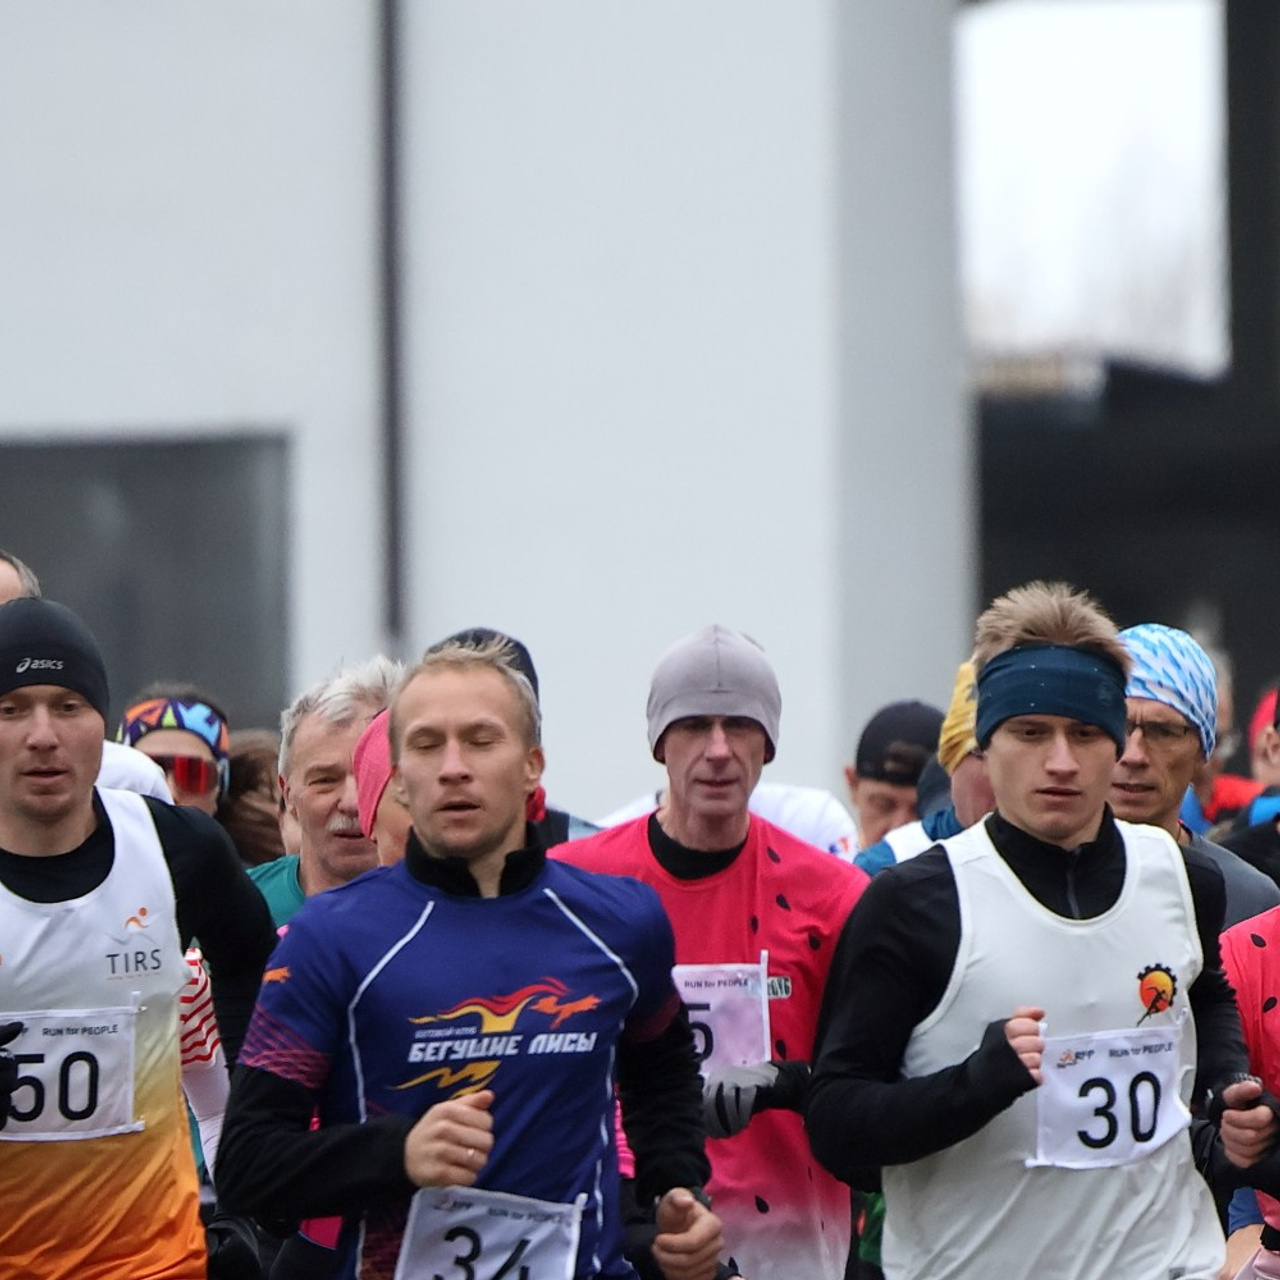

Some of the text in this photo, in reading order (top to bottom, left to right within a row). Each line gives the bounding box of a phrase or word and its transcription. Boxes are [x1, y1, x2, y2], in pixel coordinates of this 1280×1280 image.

[105, 948, 162, 974] TIRS
[684, 978, 749, 989] RUN for PEOPLE
[42, 1027, 63, 1037] RUN
[81, 1024, 119, 1036] PEOPLE
[527, 1032, 598, 1055] ЛИСЫ
[1109, 1048, 1130, 1058] RUN
[9, 1050, 99, 1122] 50
[1077, 1071, 1161, 1149] 30
